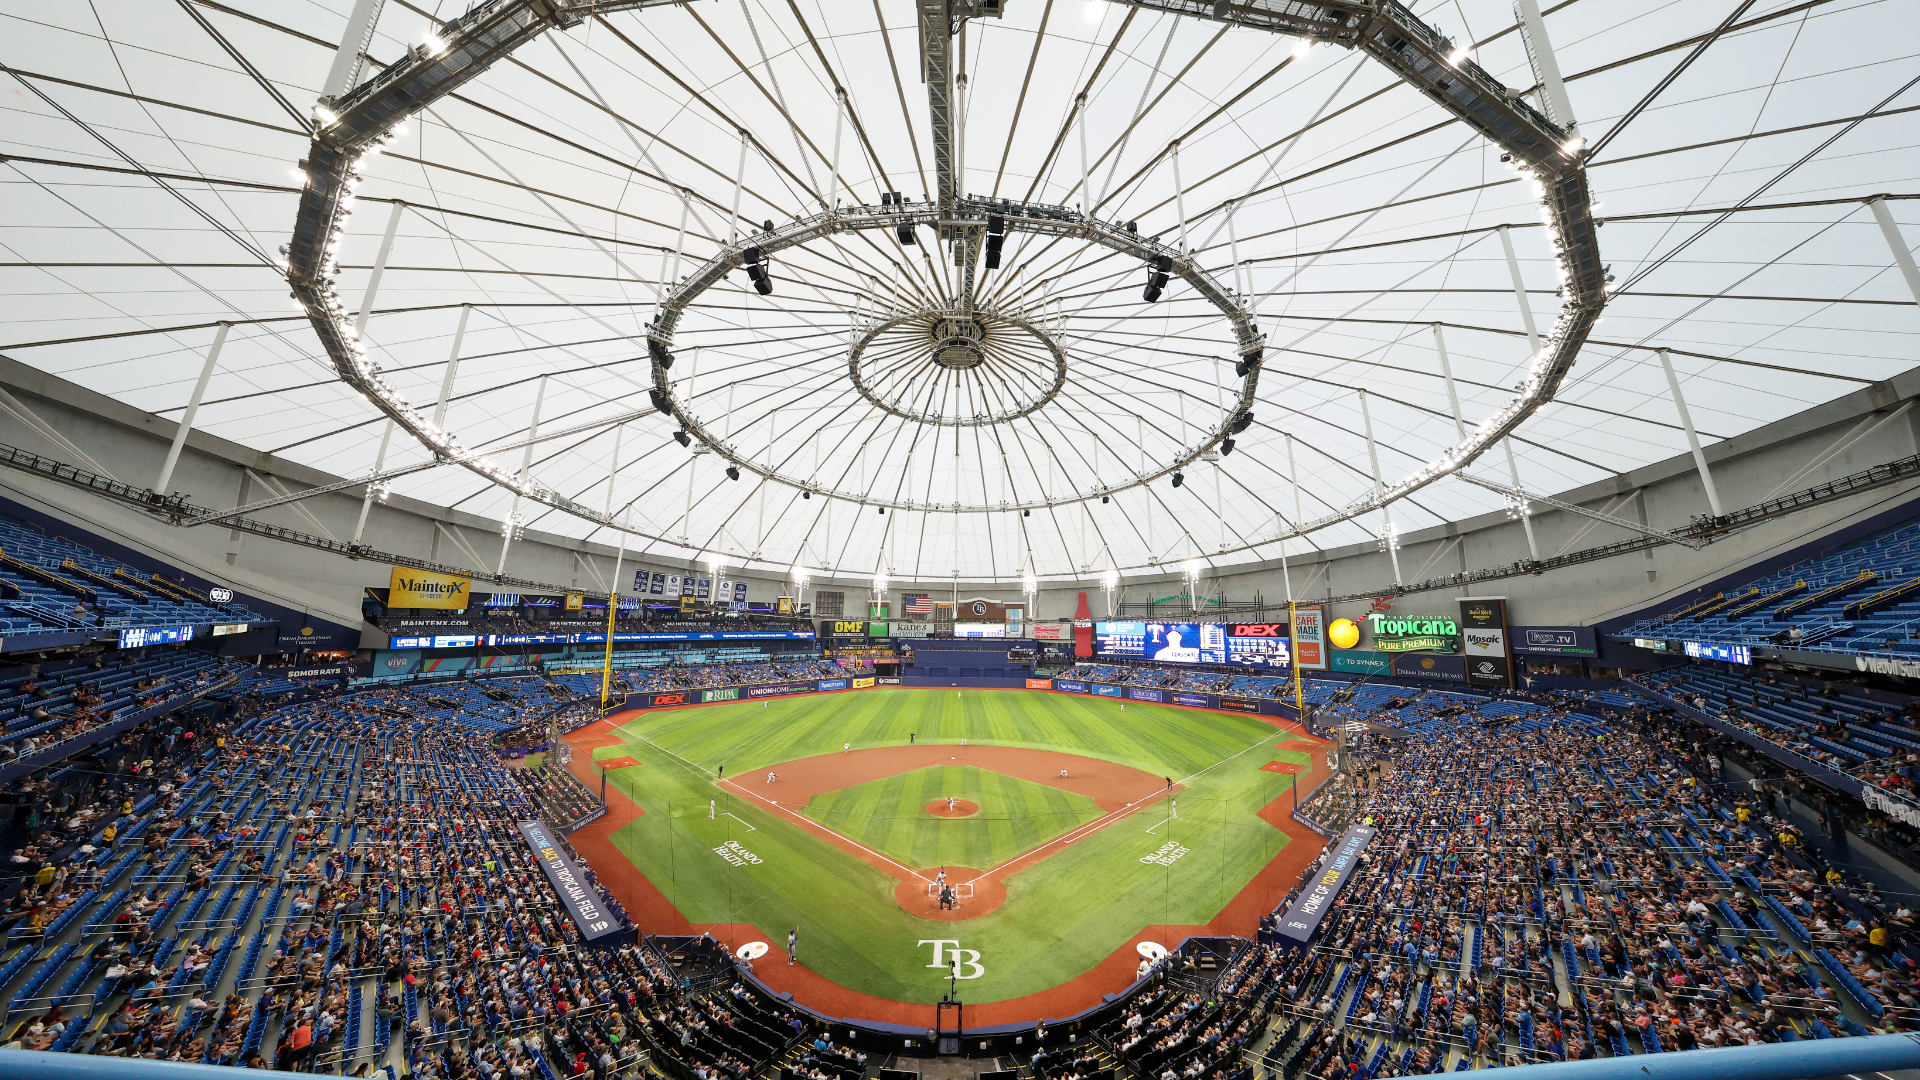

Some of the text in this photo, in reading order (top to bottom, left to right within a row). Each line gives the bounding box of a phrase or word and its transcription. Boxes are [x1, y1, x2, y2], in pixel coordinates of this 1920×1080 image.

[397, 578, 465, 597] MaintenX
[1296, 616, 1318, 626] CARE
[1368, 614, 1457, 636] Tropicana
[1234, 624, 1280, 636] DEX
[1296, 626, 1318, 634] MADE
[1378, 638, 1445, 650] PURE PREMIUM
[1467, 635, 1500, 643] Mosaic
[1417, 669, 1440, 678] FINDERS
[1865, 658, 1898, 675] Webull
[654, 694, 686, 705] DEX
[714, 690, 736, 700] RIPA
[1876, 794, 1896, 816] The
[528, 828, 551, 848] WELCOME
[541, 847, 559, 862] BACK
[712, 846, 747, 867] HEALTH
[724, 840, 763, 864] ORLANDO
[1139, 841, 1180, 864] ORLANDO
[1156, 846, 1191, 867] HEALTH
[550, 860, 562, 869] TO
[1331, 855, 1352, 871] TAMPA
[554, 867, 586, 903] TROPICANA
[1320, 870, 1341, 885] YOUR
[1315, 884, 1330, 895] OF
[575, 896, 600, 920] FIELD
[1300, 894, 1325, 915] HOME
[917, 939, 985, 980] TB
